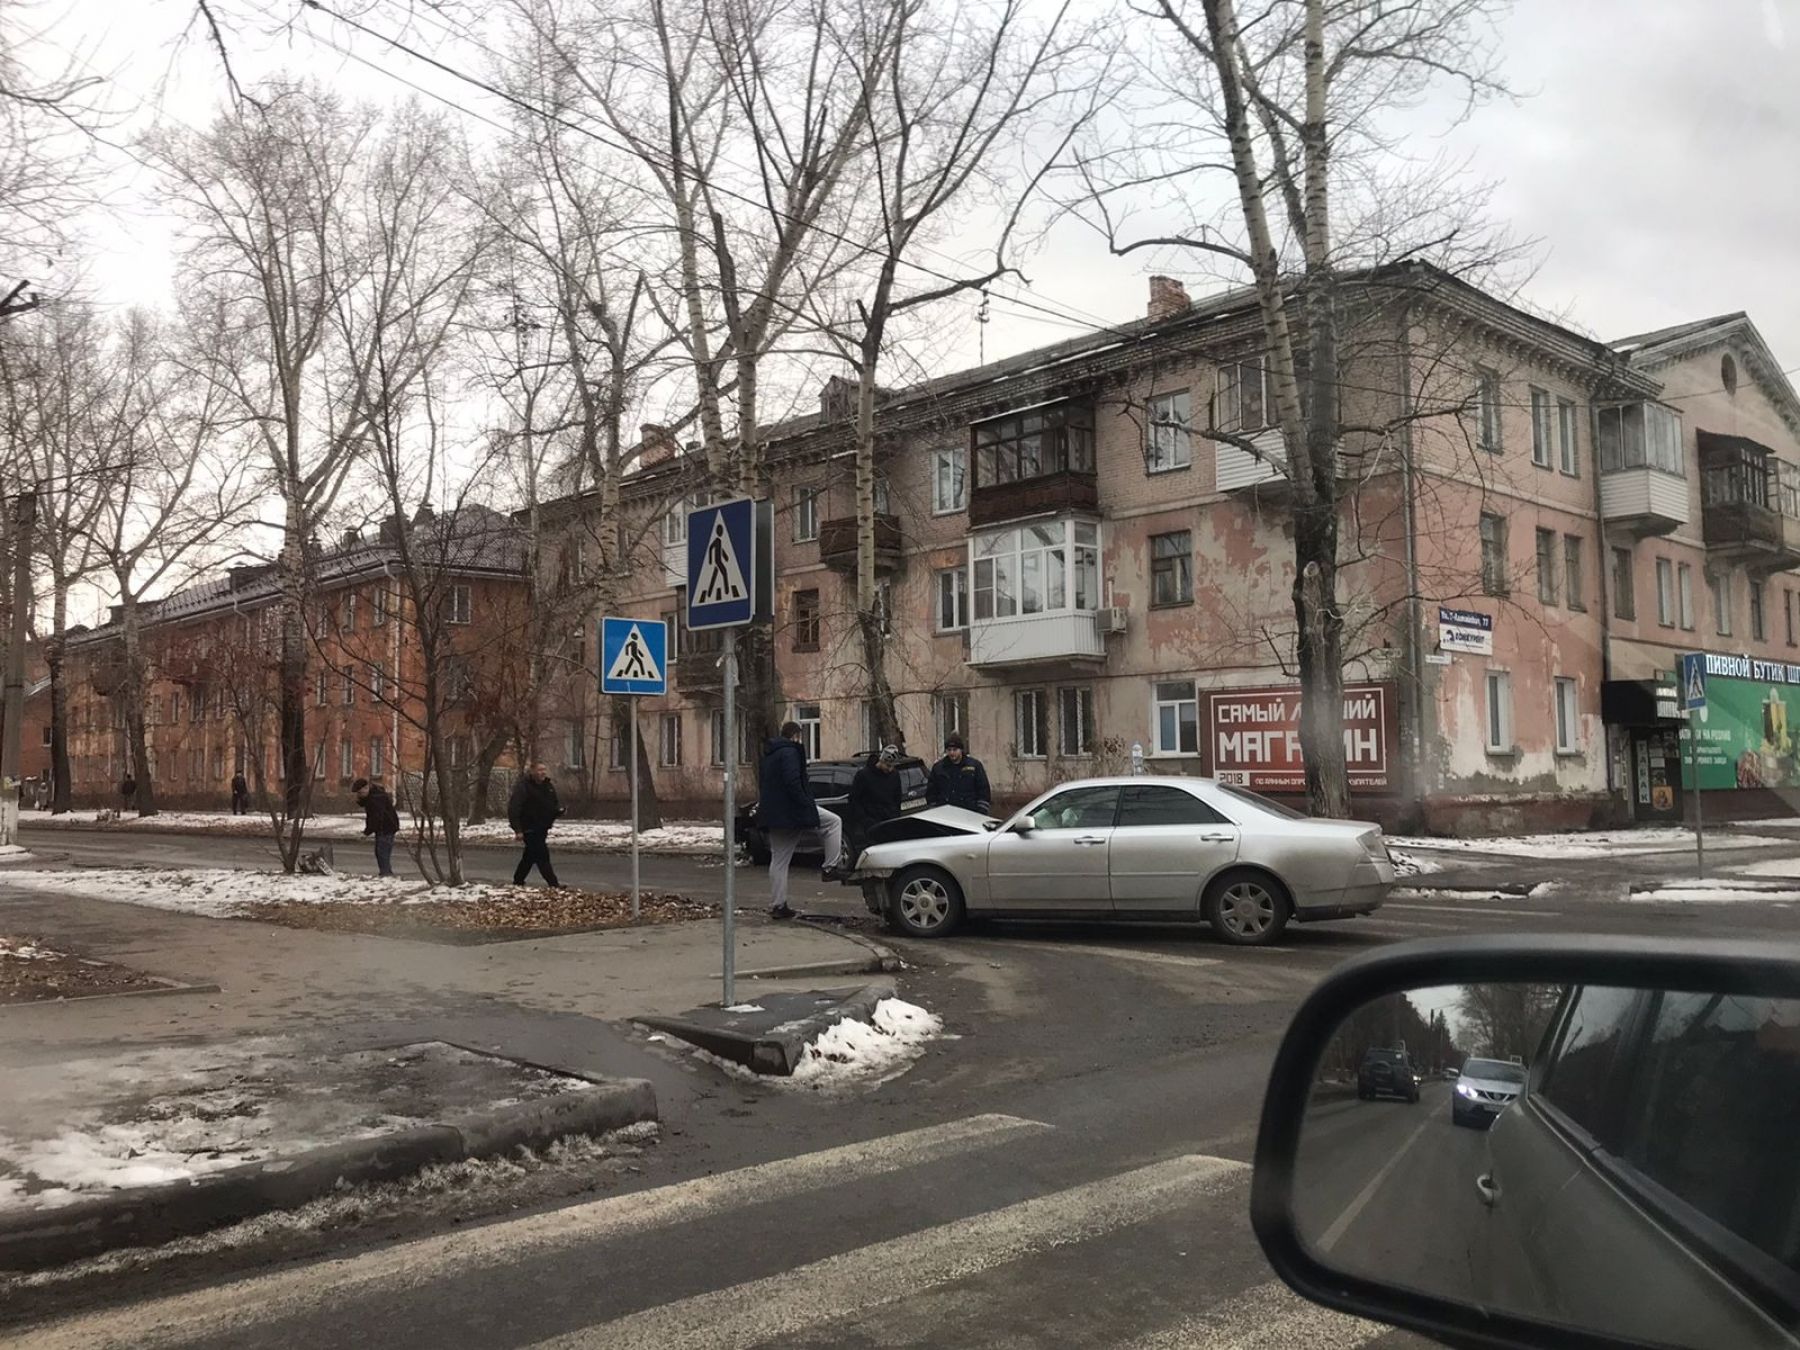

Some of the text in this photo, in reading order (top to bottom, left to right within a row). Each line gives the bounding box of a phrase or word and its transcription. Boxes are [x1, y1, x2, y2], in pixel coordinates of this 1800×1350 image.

[1706, 653, 1750, 677] ПИВНОЙ
[1753, 661, 1785, 682] БУТИК
[1218, 694, 1376, 723] САМЫЙ ЛИЙ
[1219, 773, 1243, 785] 2018
